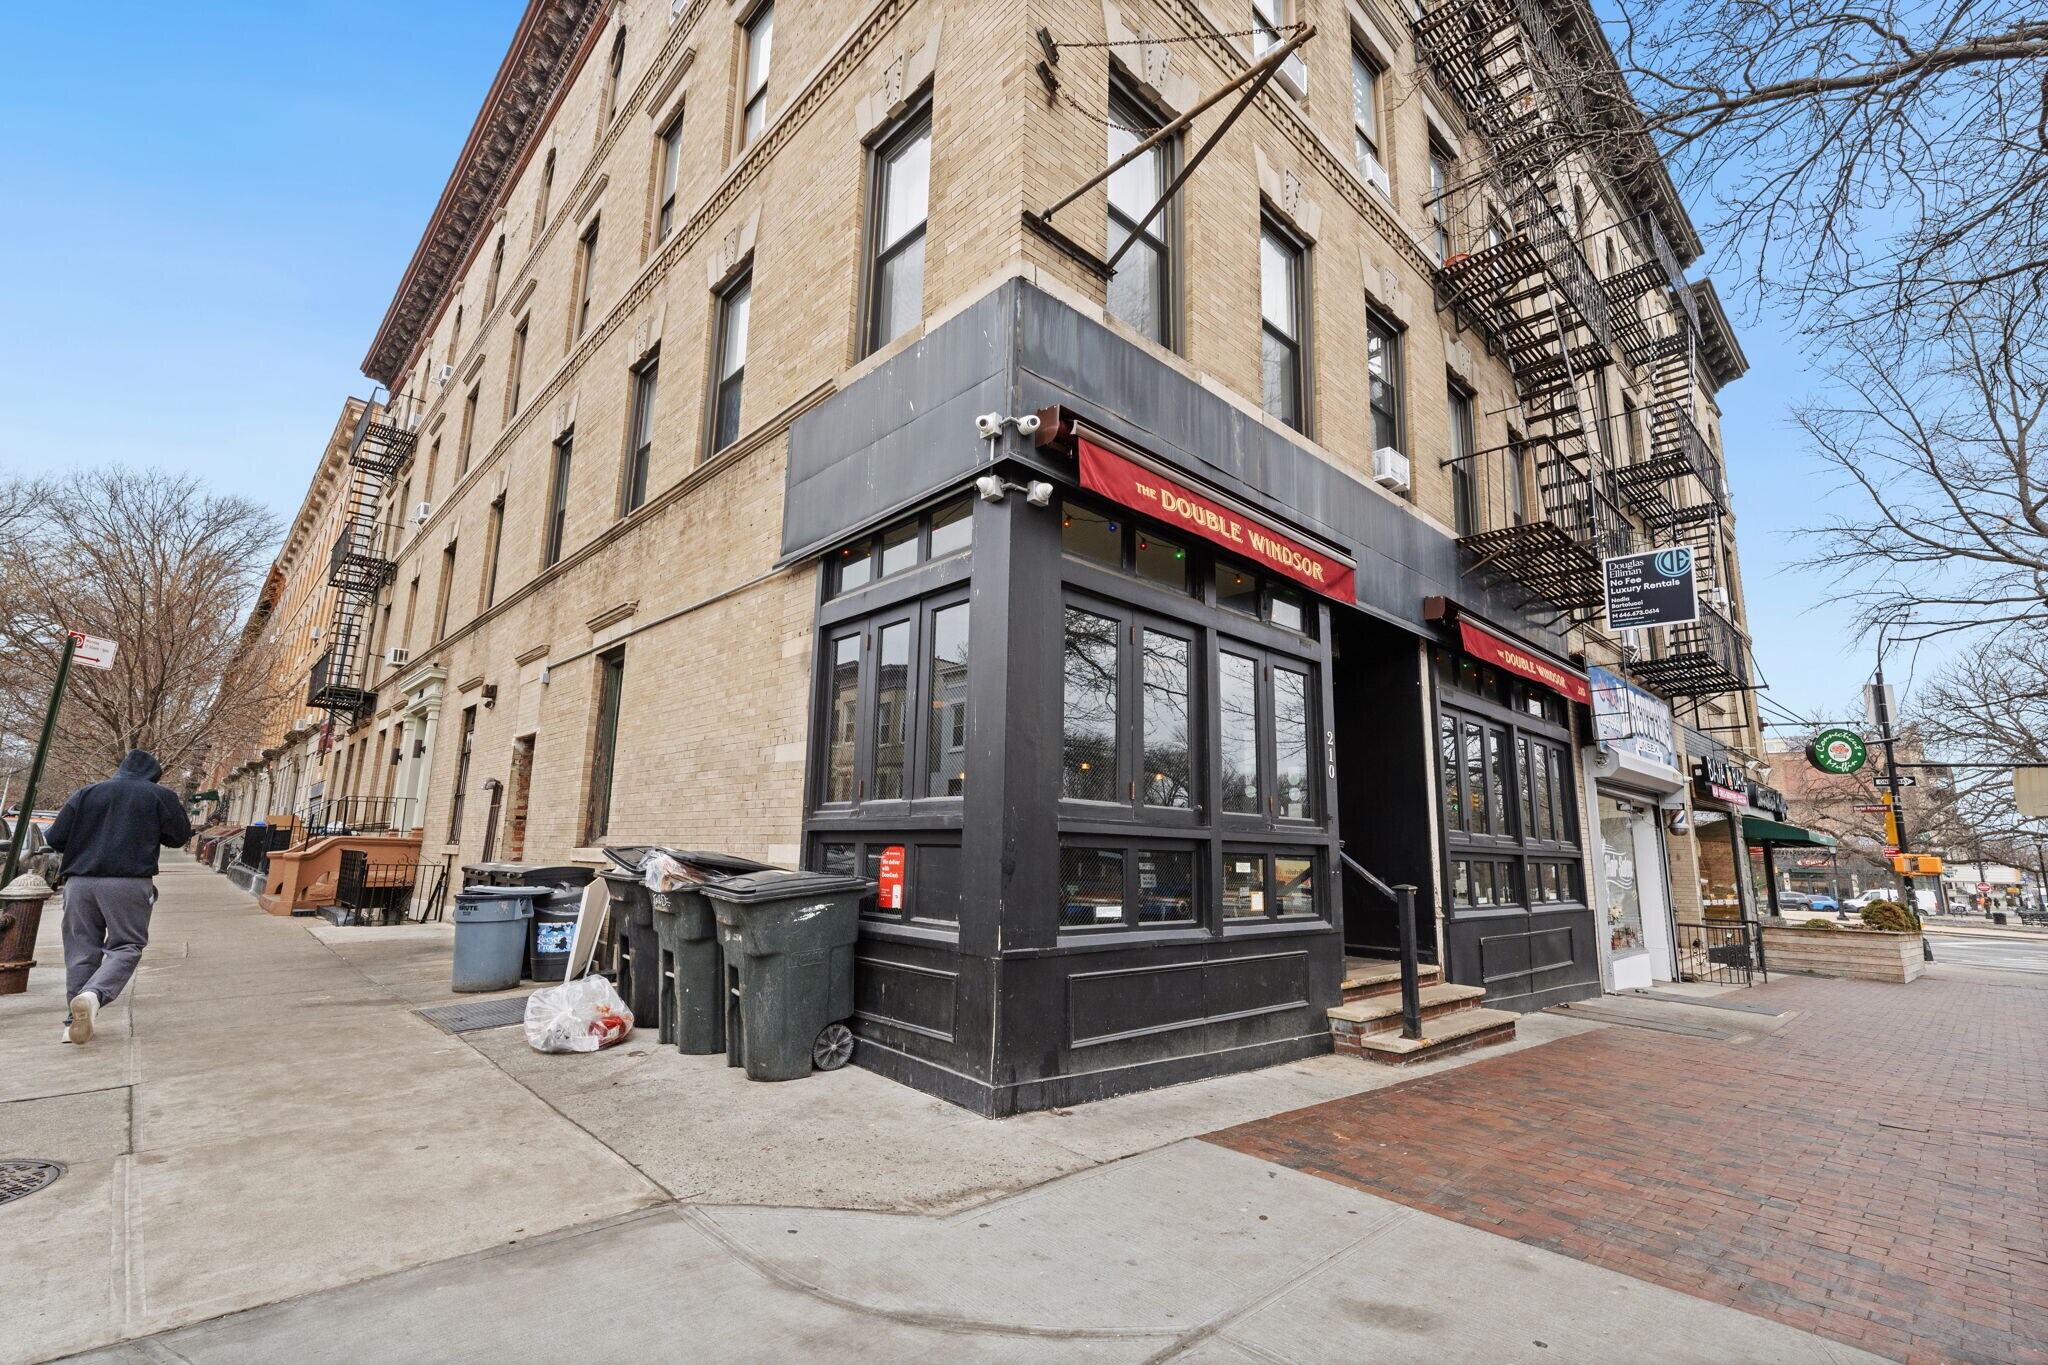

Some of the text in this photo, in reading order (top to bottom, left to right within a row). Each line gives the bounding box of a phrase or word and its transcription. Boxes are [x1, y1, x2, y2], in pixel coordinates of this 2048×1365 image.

[1135, 482, 1325, 583] THE DOUBLE WINDSOR
[1608, 559, 1645, 571] Douglas
[1609, 568, 1642, 579] Elliman
[1610, 577, 1642, 587] No Fee
[1610, 578, 1681, 595] Luxury Rentals
[1504, 650, 1537, 675] DOUBLE
[1535, 664, 1568, 690] WINDSOR
[1815, 731, 1863, 752] Connecticut
[1327, 731, 1335, 779] 210
[1826, 759, 1858, 773] Muffin
